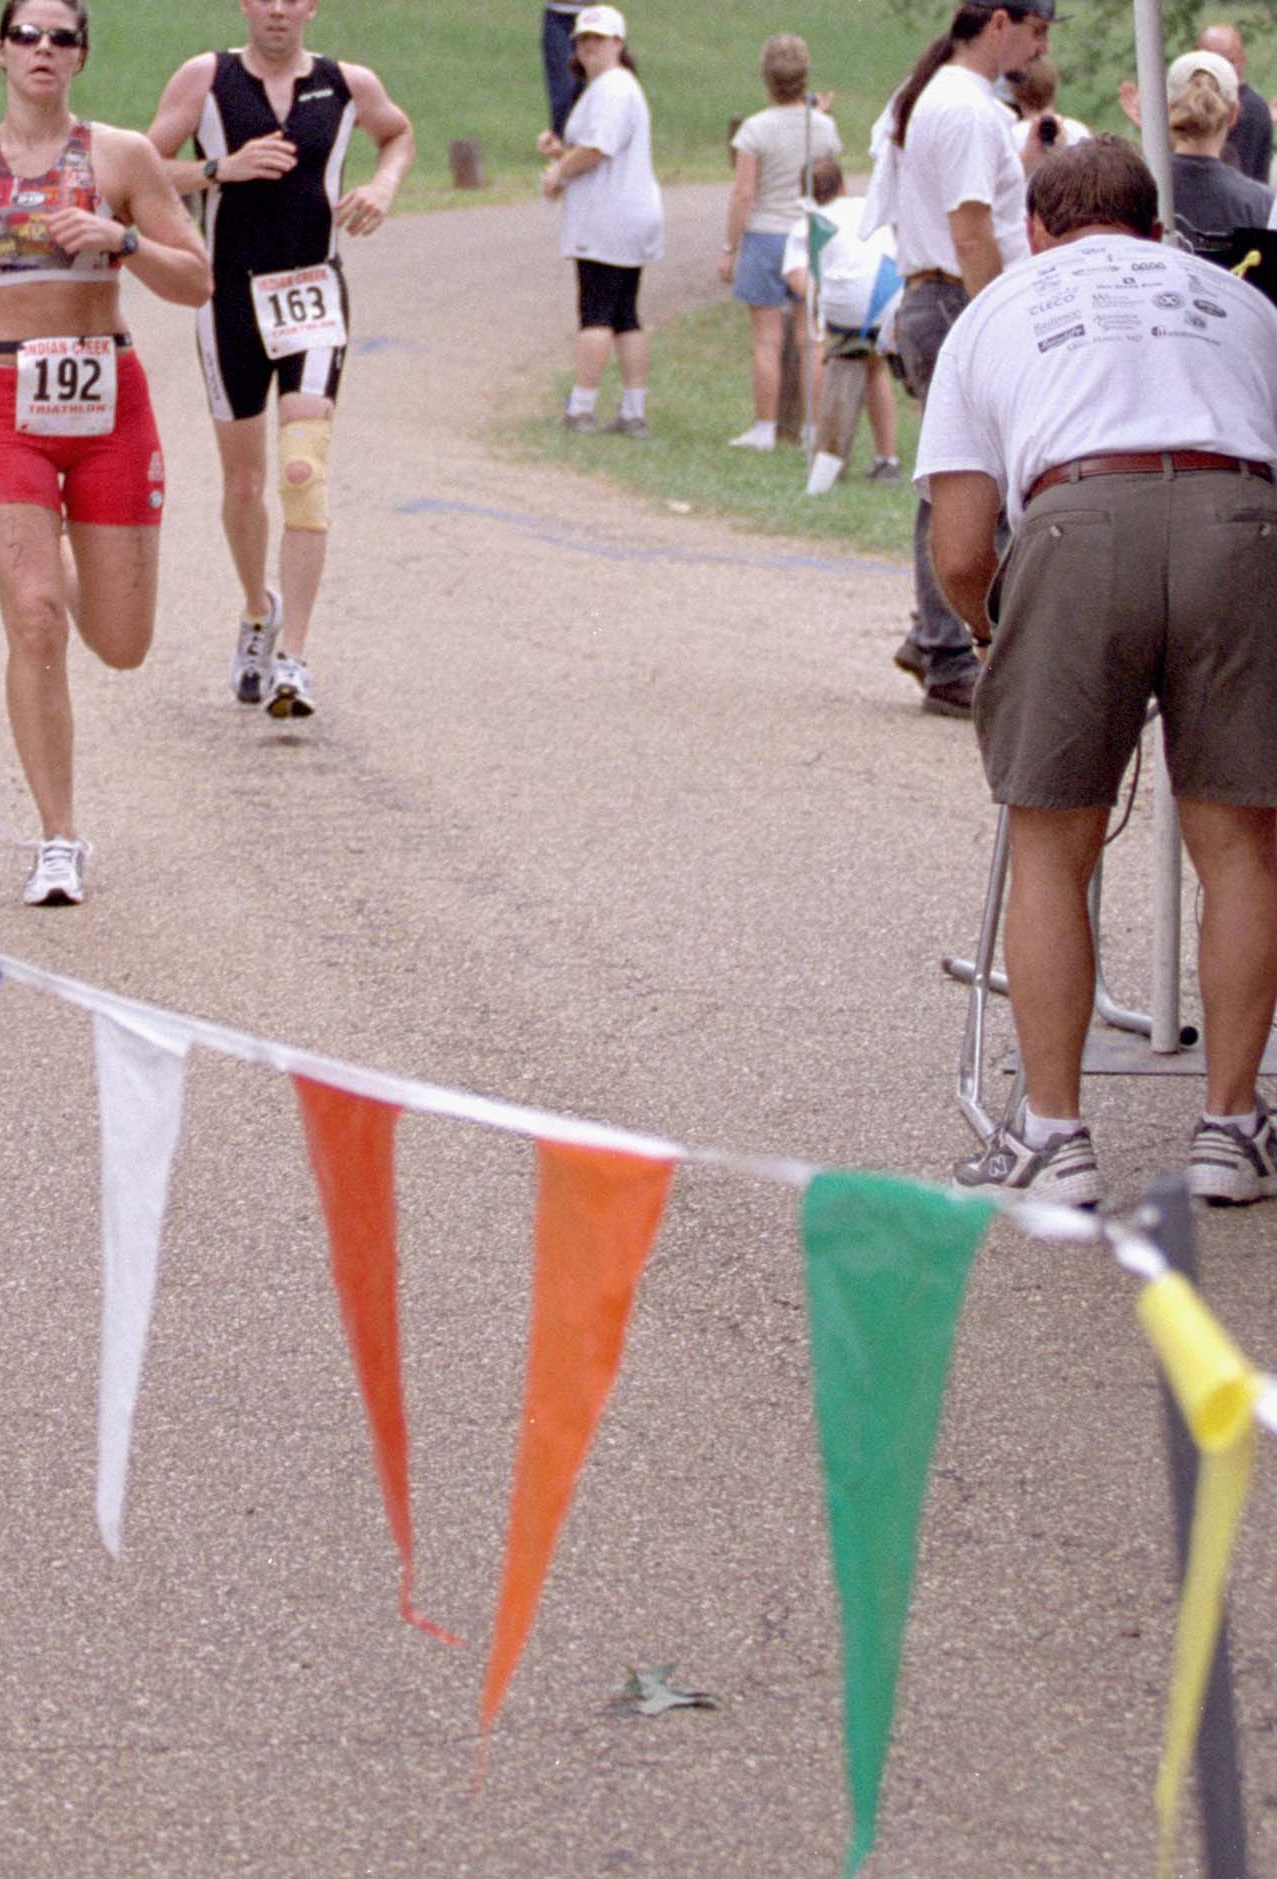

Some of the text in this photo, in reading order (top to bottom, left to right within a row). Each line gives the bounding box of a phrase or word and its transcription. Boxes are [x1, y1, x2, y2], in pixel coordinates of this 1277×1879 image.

[268, 285, 327, 328] 163
[1029, 293, 1076, 316] CLECO
[33, 358, 102, 402] 192
[28, 403, 107, 415] TRIATHLON
